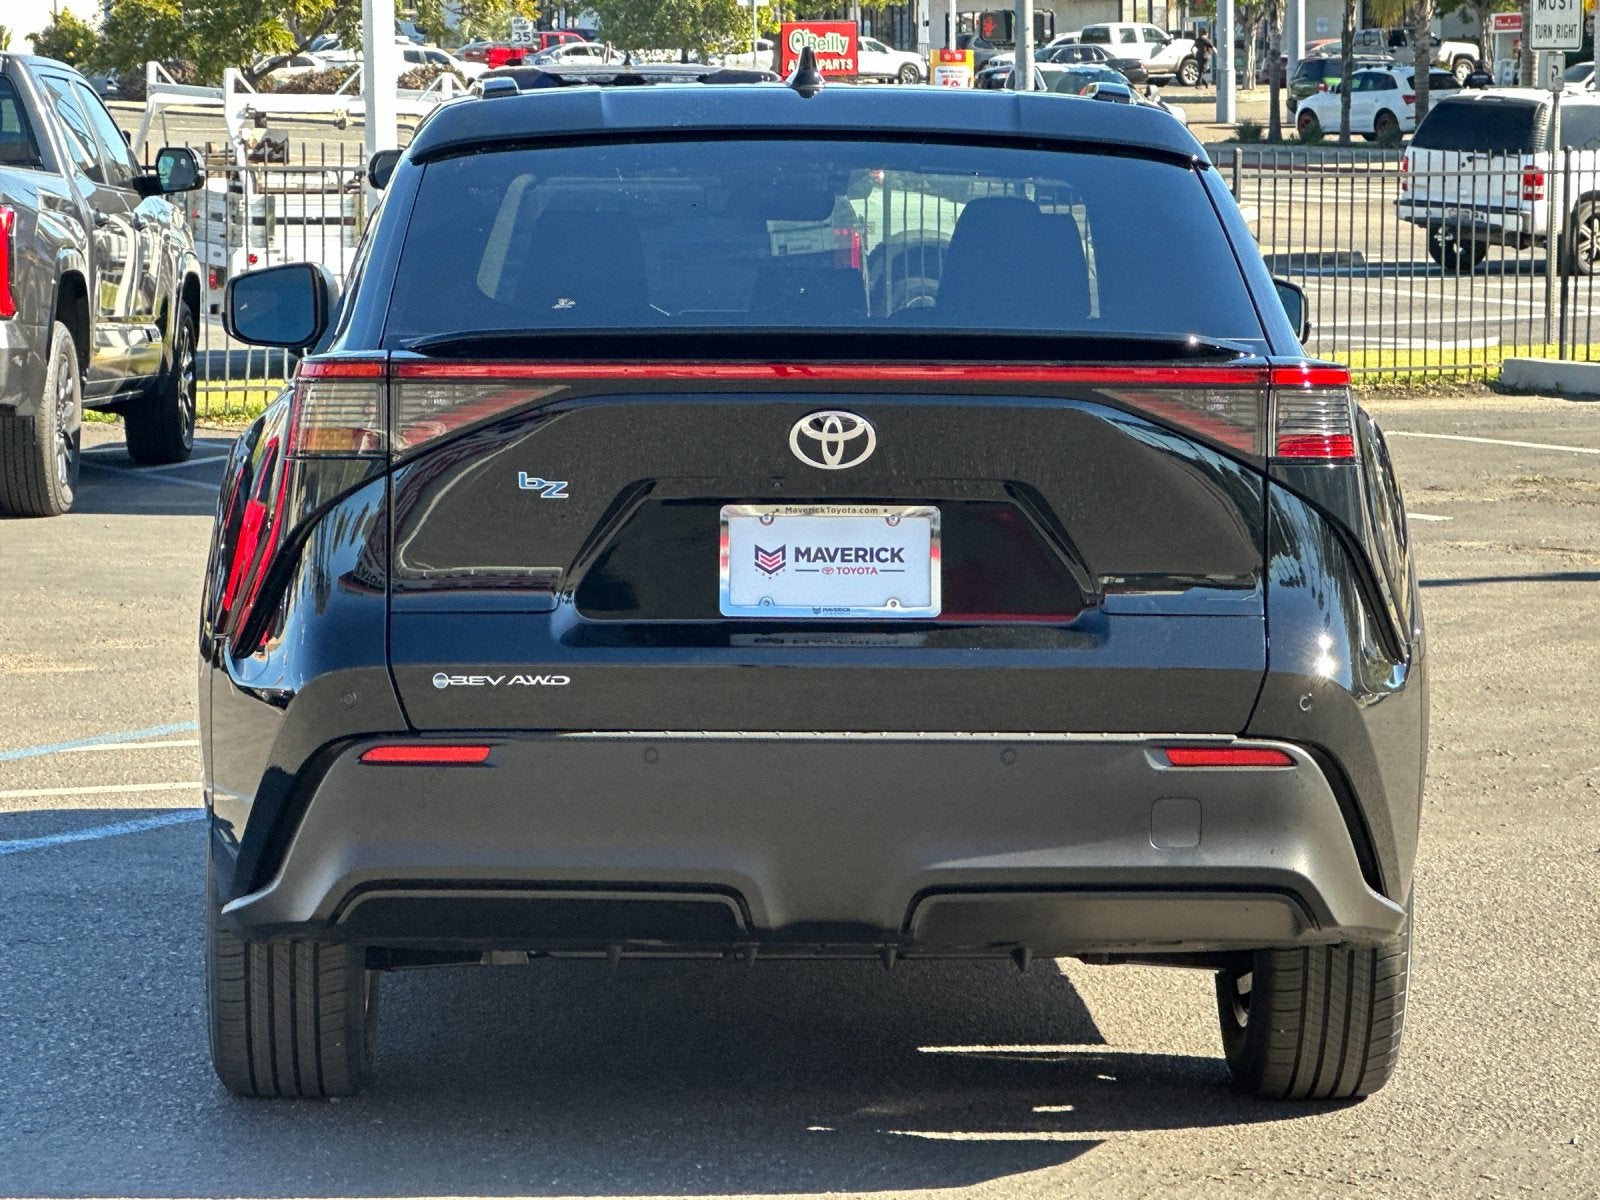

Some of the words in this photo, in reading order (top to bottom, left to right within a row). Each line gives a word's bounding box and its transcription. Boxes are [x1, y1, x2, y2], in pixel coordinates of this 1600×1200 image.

[514, 31, 531, 43] 35
[1535, 24, 1552, 39] TURN
[1556, 24, 1577, 39] RIGHT
[789, 28, 849, 56] O'Reilly
[819, 59, 854, 71] PARTS
[785, 506, 878, 515] MaverickToyota.com
[794, 547, 905, 563] MAVERICK
[836, 566, 878, 575] TOYOTA
[507, 675, 571, 686] AWD
